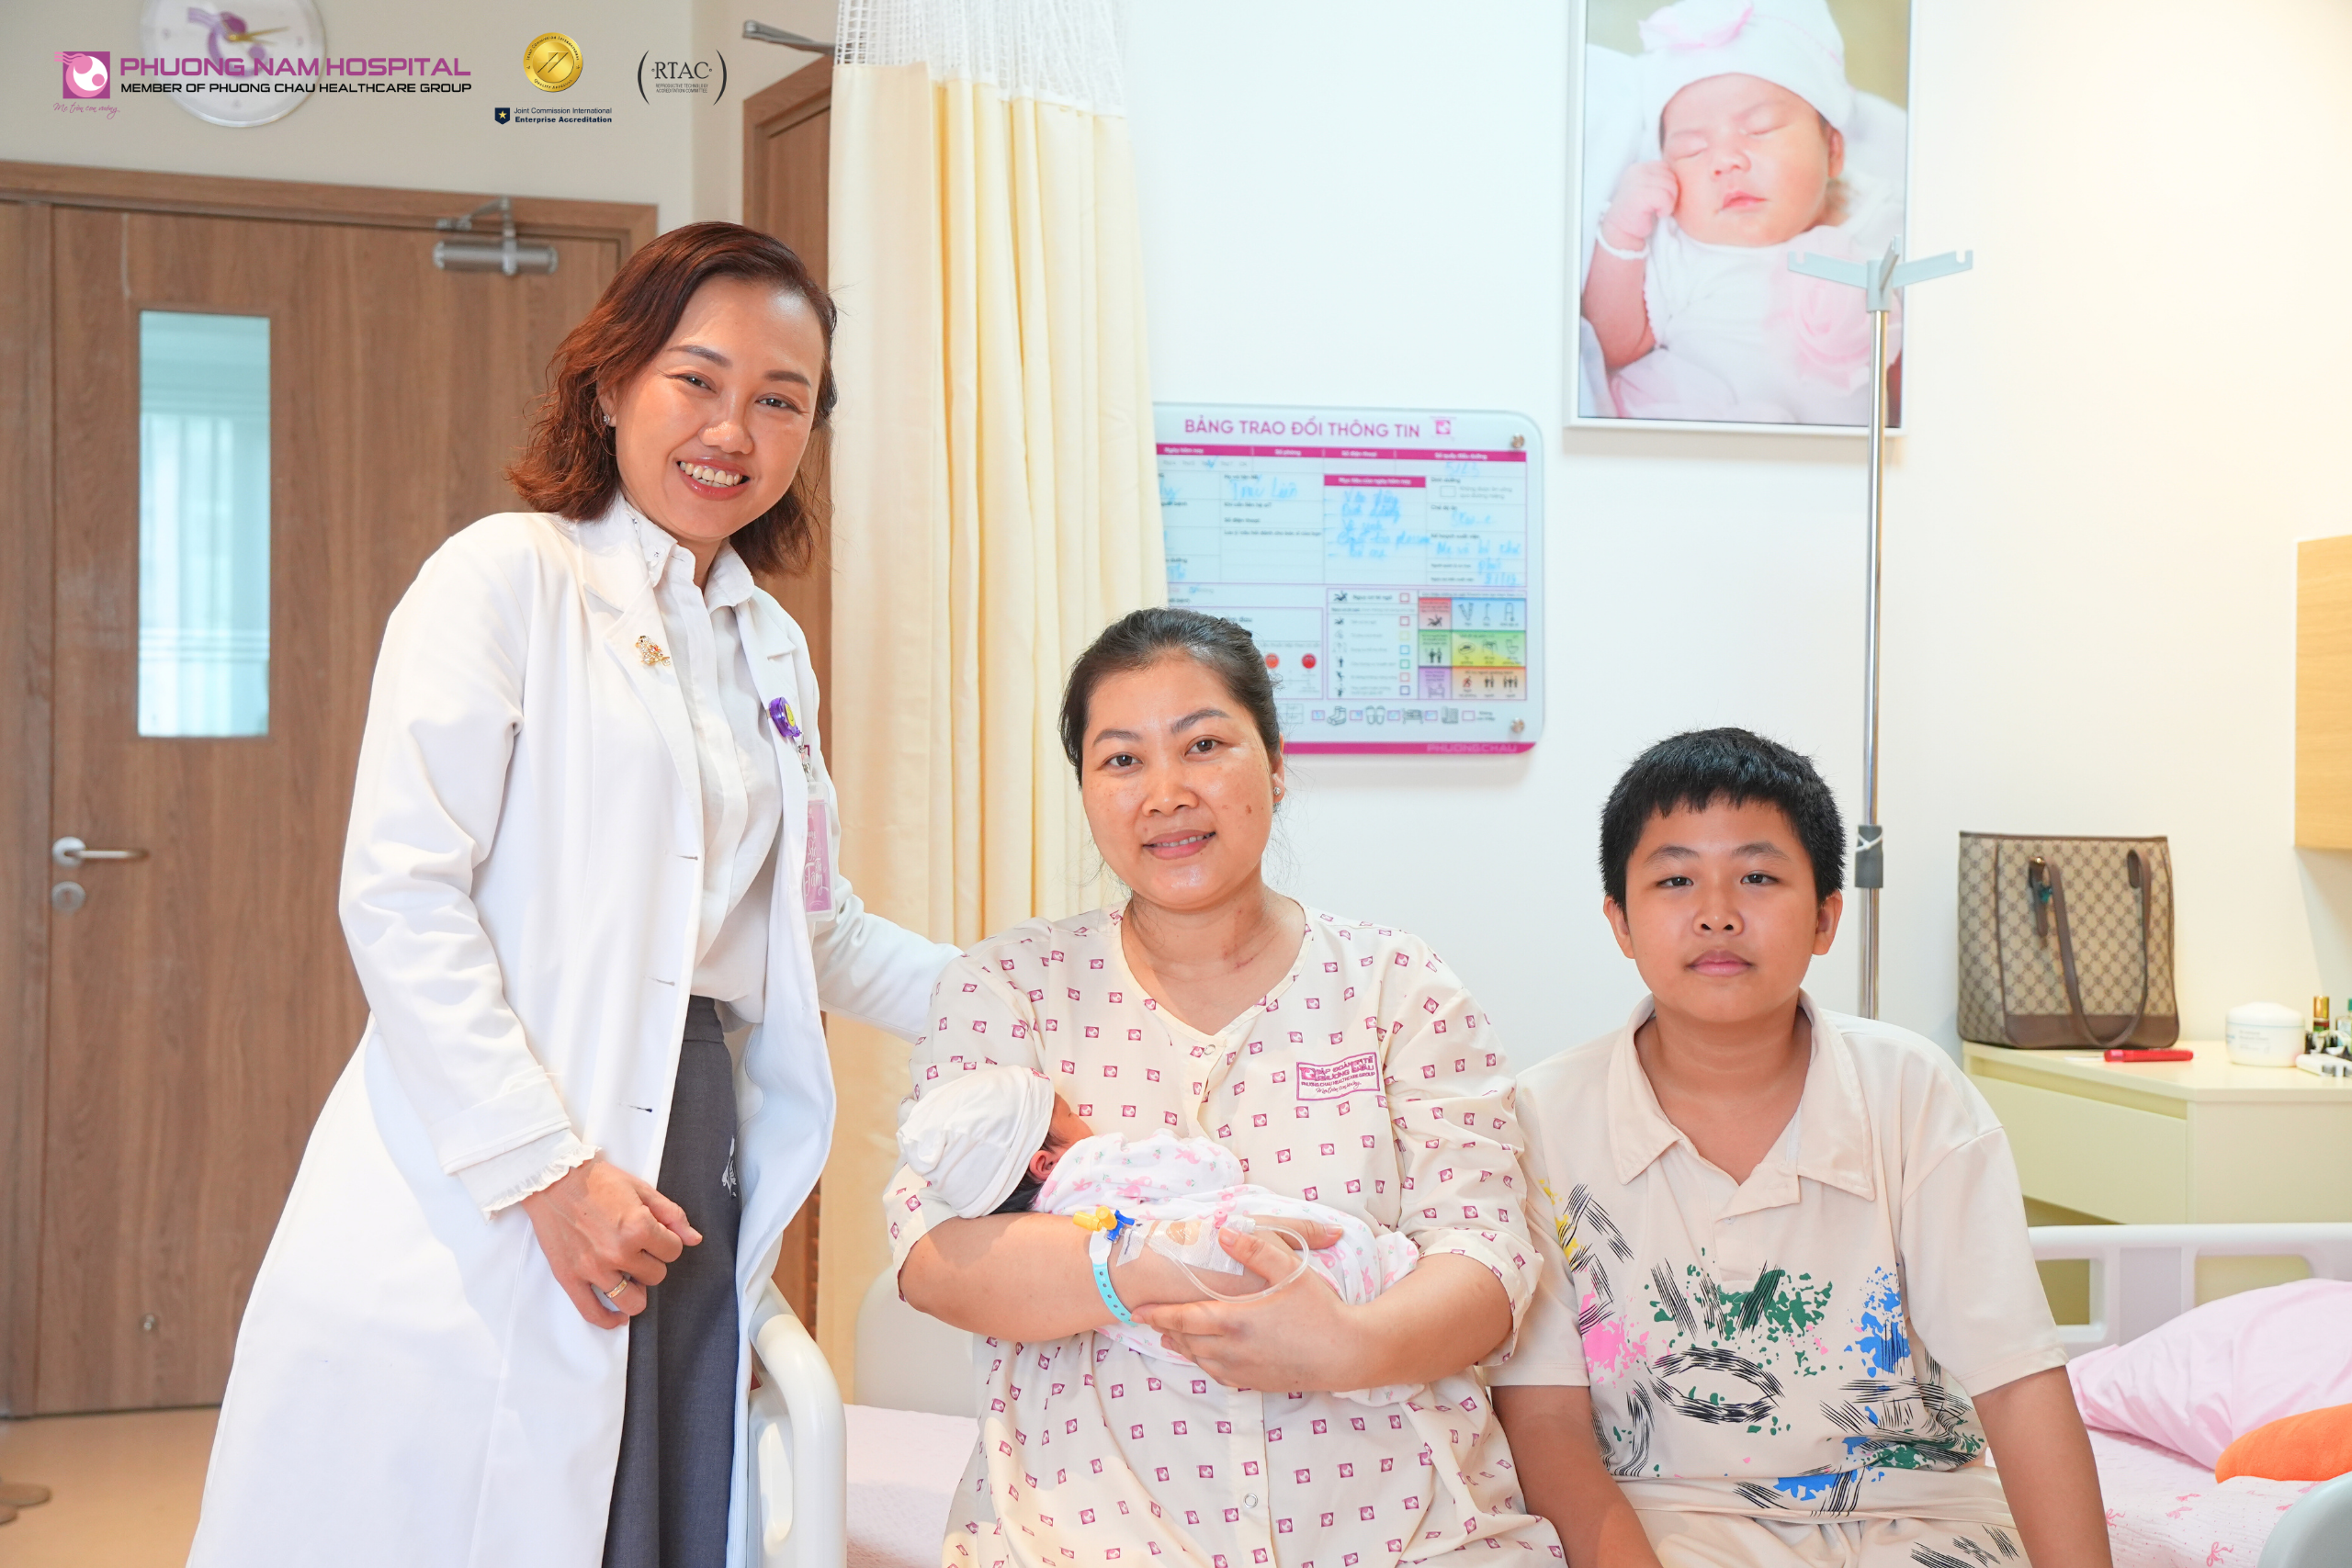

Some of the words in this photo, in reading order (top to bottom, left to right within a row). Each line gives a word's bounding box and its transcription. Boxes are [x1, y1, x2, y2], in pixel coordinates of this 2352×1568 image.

[1185, 414, 1234, 434] BẢNG
[1239, 421, 1285, 434] TRAO
[1291, 415, 1322, 435] ĐỔI
[1328, 419, 1389, 437] THÔNG
[1395, 423, 1419, 437] TIN
